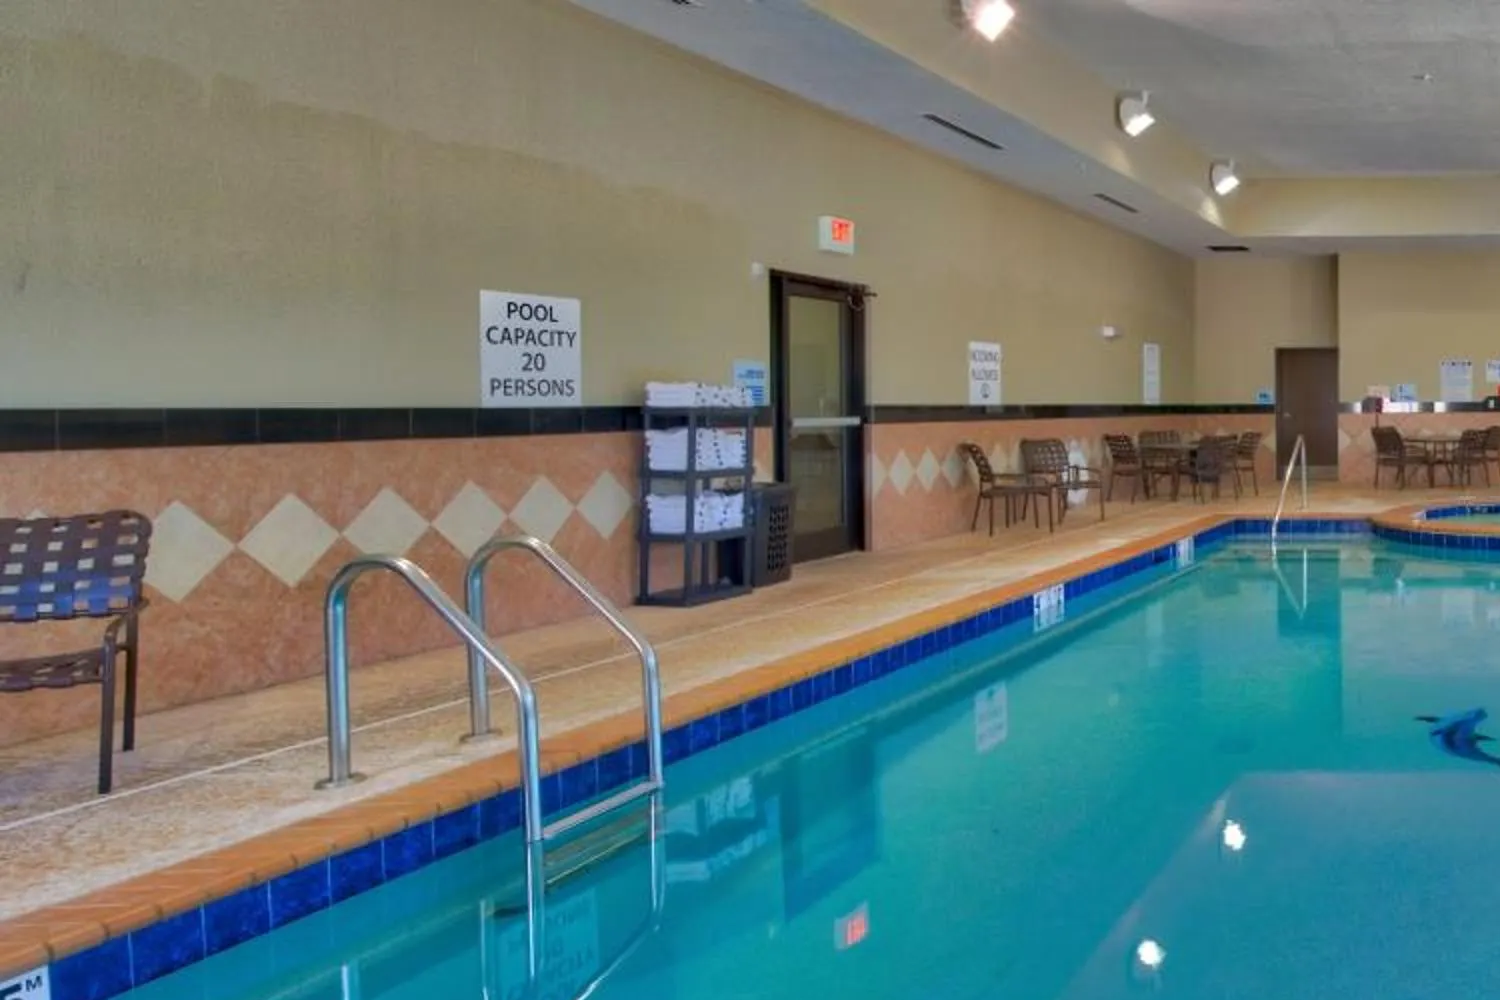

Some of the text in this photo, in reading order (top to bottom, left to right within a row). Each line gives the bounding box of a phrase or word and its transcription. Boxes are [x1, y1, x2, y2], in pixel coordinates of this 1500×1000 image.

[507, 301, 559, 323] POOL
[486, 326, 577, 348] CAPACITY
[521, 352, 546, 372] 20
[490, 378, 575, 397] PERSONS
